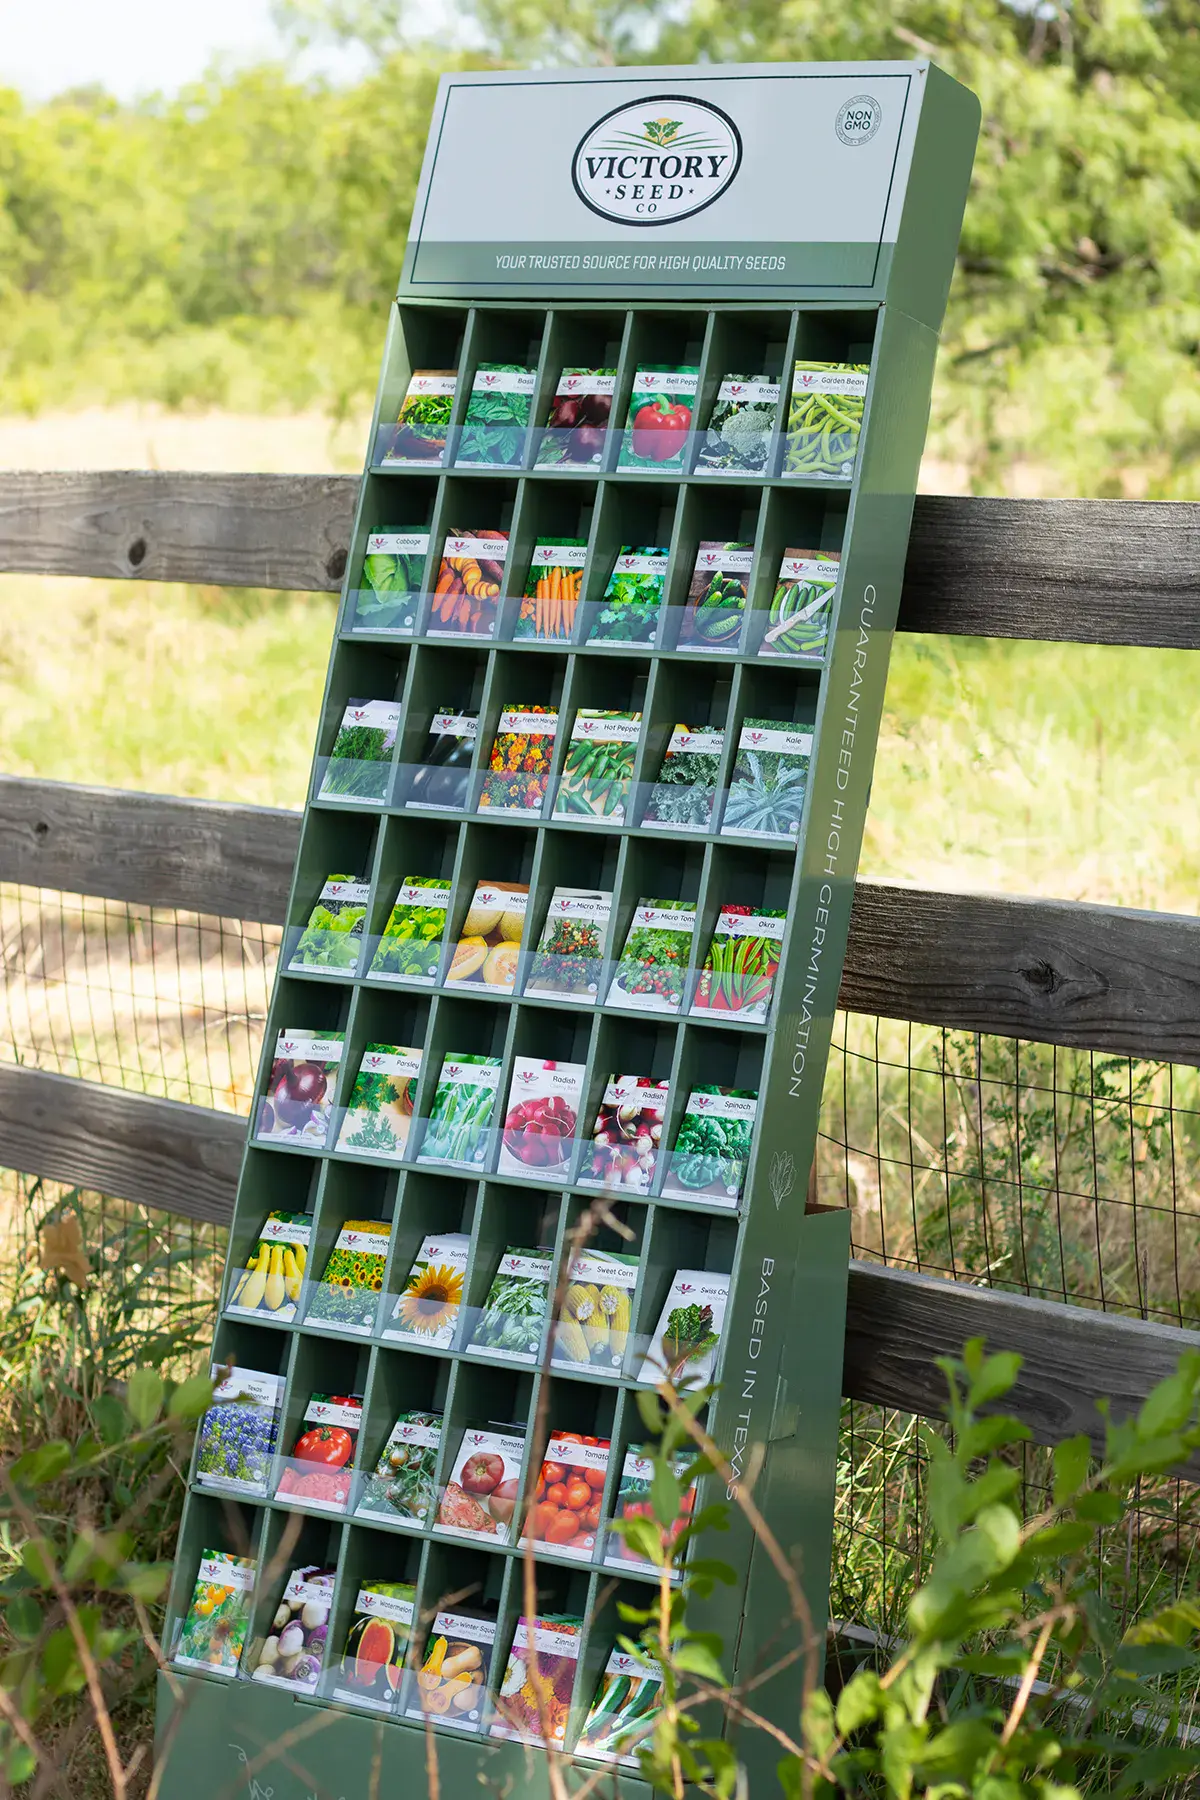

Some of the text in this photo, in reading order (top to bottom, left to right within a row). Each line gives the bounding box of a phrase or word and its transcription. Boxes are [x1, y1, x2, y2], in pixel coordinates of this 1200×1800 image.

[846, 110, 872, 120] NON
[844, 120, 871, 130] GMO
[585, 155, 728, 179] VICTORY
[614, 184, 684, 200] SEED
[635, 203, 657, 213] CO
[495, 255, 786, 271] YOUR TRUSTED SOURCE FOR HIGH QUALITY SEEDS
[617, 725, 640, 733] Pepper
[788, 584, 876, 1097] GUARANTEED HIGH GERMINATION
[396, 1060, 419, 1069] Parsley
[553, 1076, 576, 1084] Radish
[725, 1101, 751, 1110] Spinach
[530, 1262, 550, 1270] Sweet
[597, 1266, 616, 1275] Sweet
[725, 1257, 775, 1501] BASED IN TEXAS
[248, 1384, 262, 1392] Texas
[500, 1439, 524, 1449] Tomato
[584, 1450, 609, 1460] Tomato
[231, 1570, 251, 1580] Tomato
[380, 1600, 412, 1614] Watermelon
[460, 1622, 479, 1630] Winter
[555, 1637, 575, 1646] Zinnia
